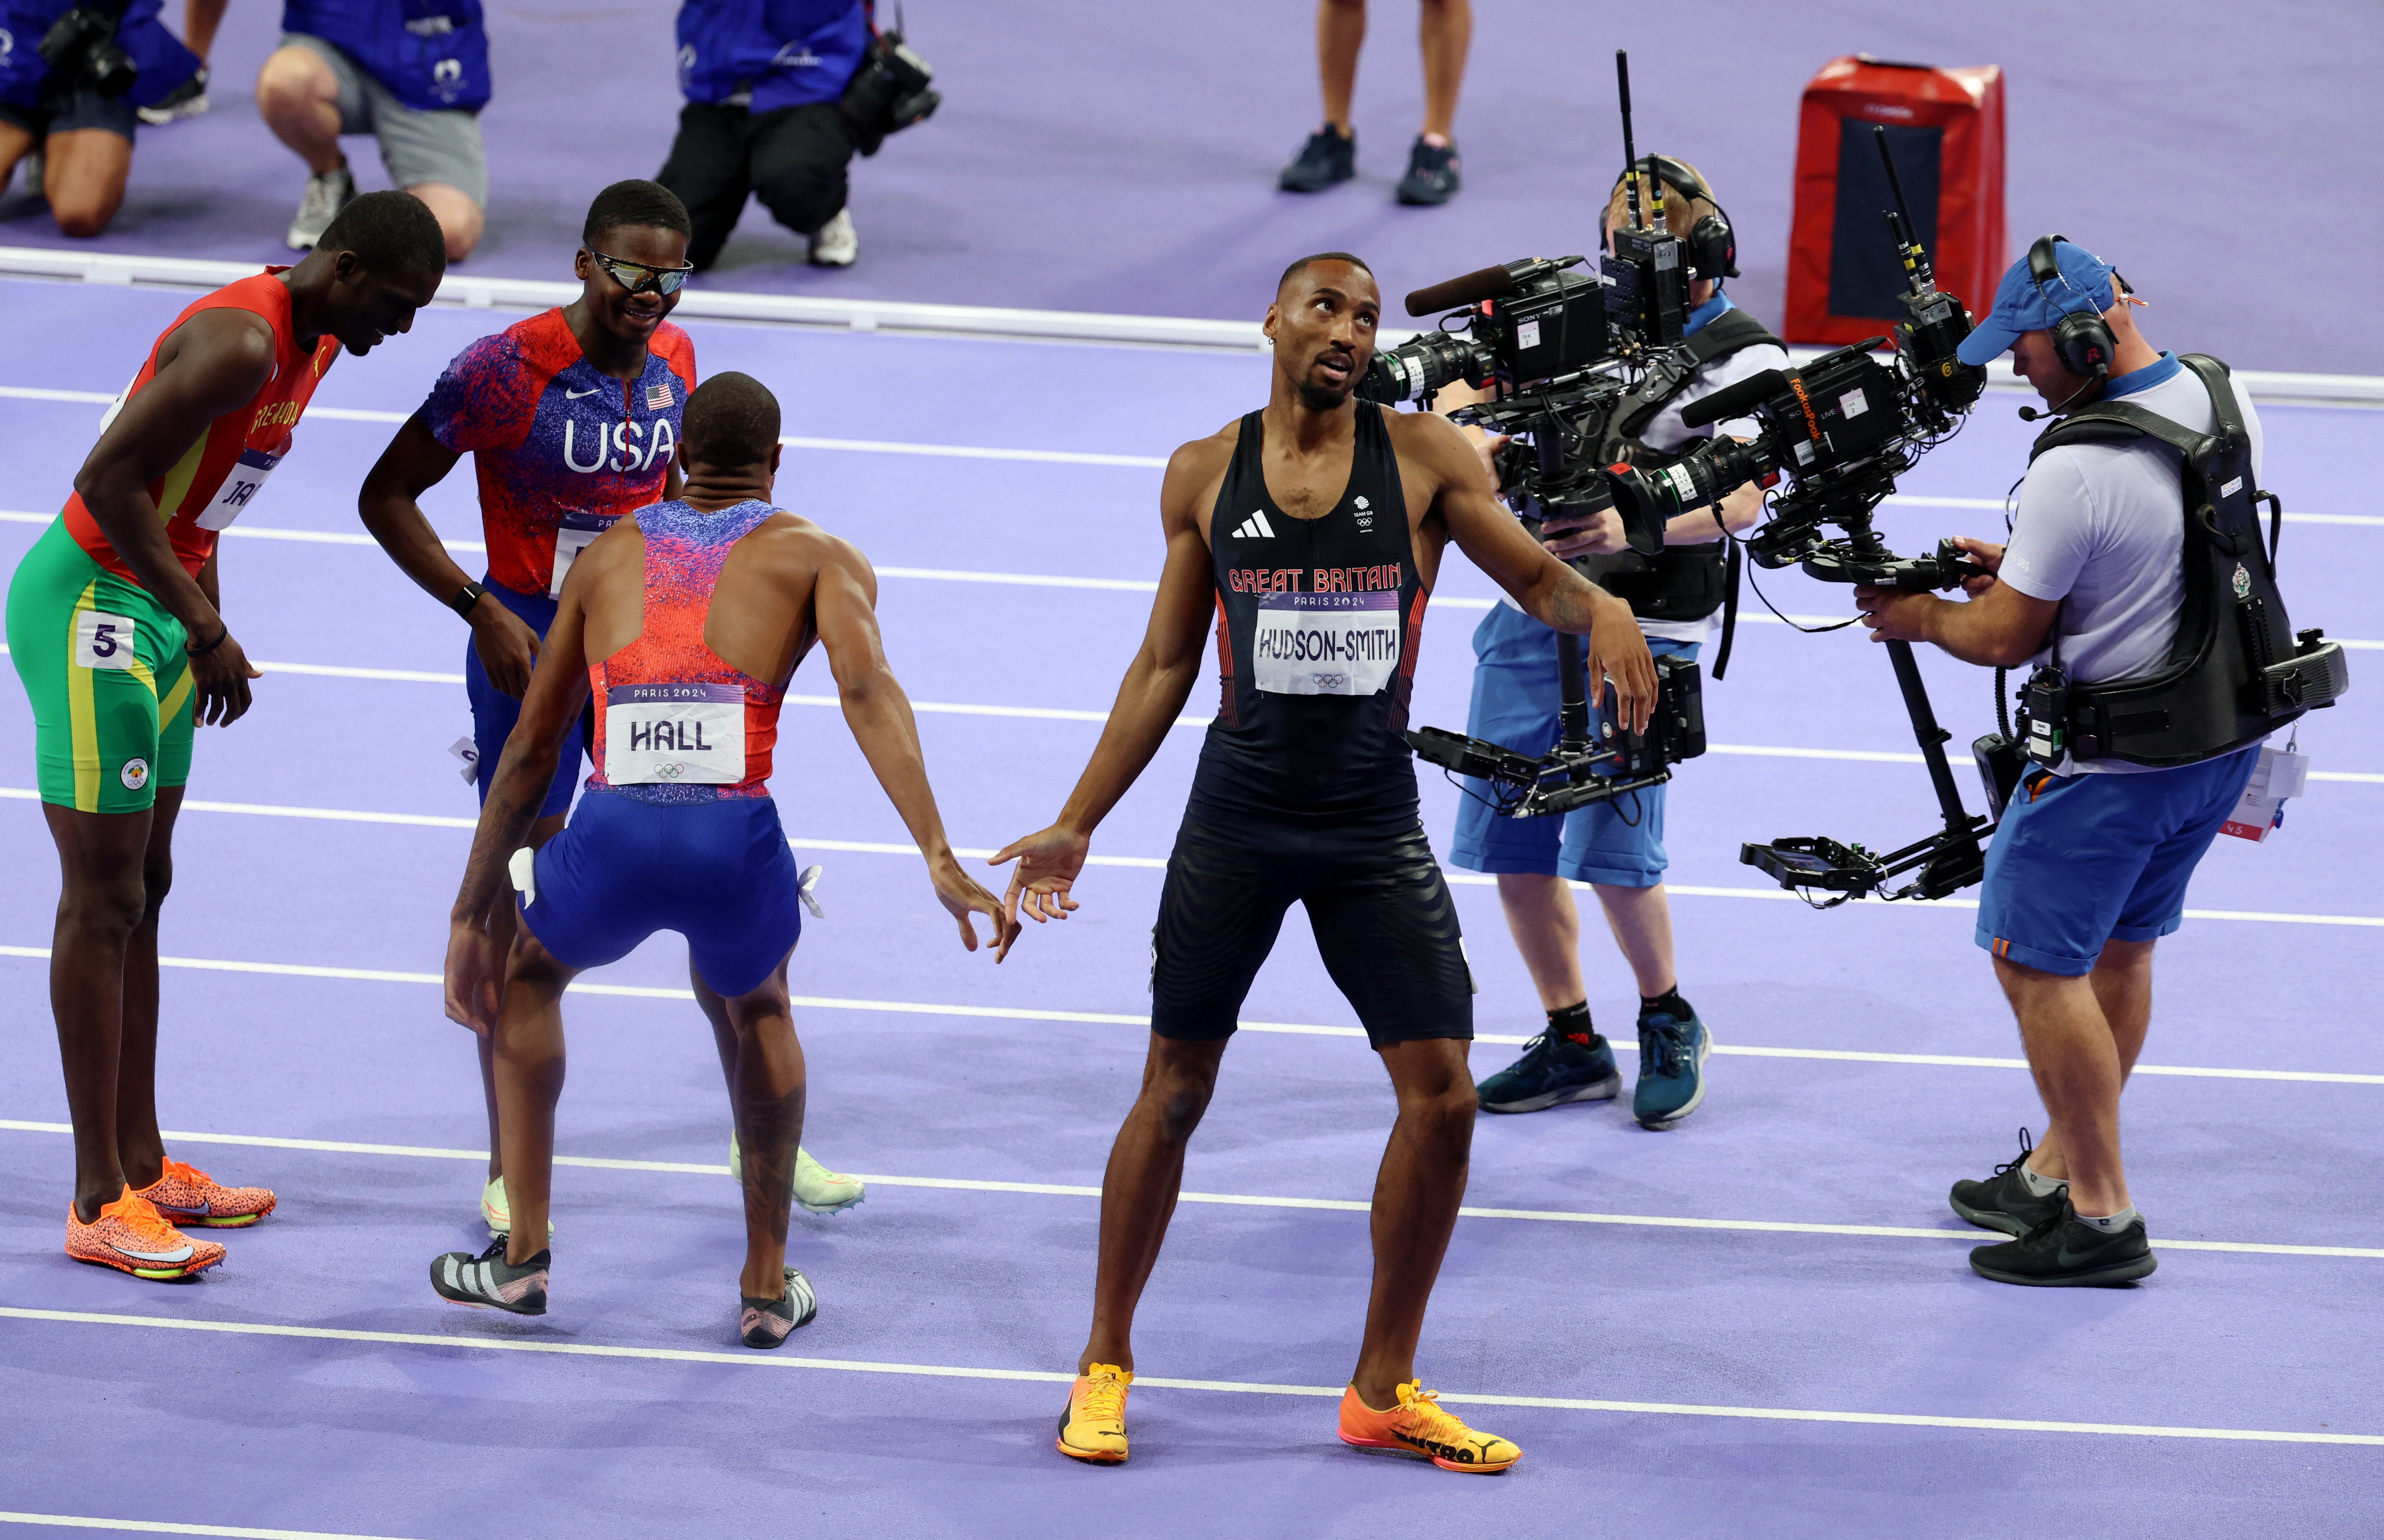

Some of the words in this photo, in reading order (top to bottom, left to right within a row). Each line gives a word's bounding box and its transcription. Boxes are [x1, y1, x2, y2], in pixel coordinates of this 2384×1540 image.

[1517, 313, 1541, 324] SONY
[251, 401, 299, 434] GRENADA
[1789, 410, 1802, 419] SO
[1821, 408, 1836, 420] LIVE
[564, 418, 675, 473] USA
[1755, 454, 1770, 462] Canon
[1229, 569, 1303, 593] GREAT
[1314, 563, 1402, 593] BRITAIN
[1334, 597, 1364, 606] 2024
[93, 624, 117, 658] 5
[1259, 629, 1396, 661] HUDSON-SMITH
[674, 689, 706, 697] 2024
[631, 720, 712, 751] HALL
